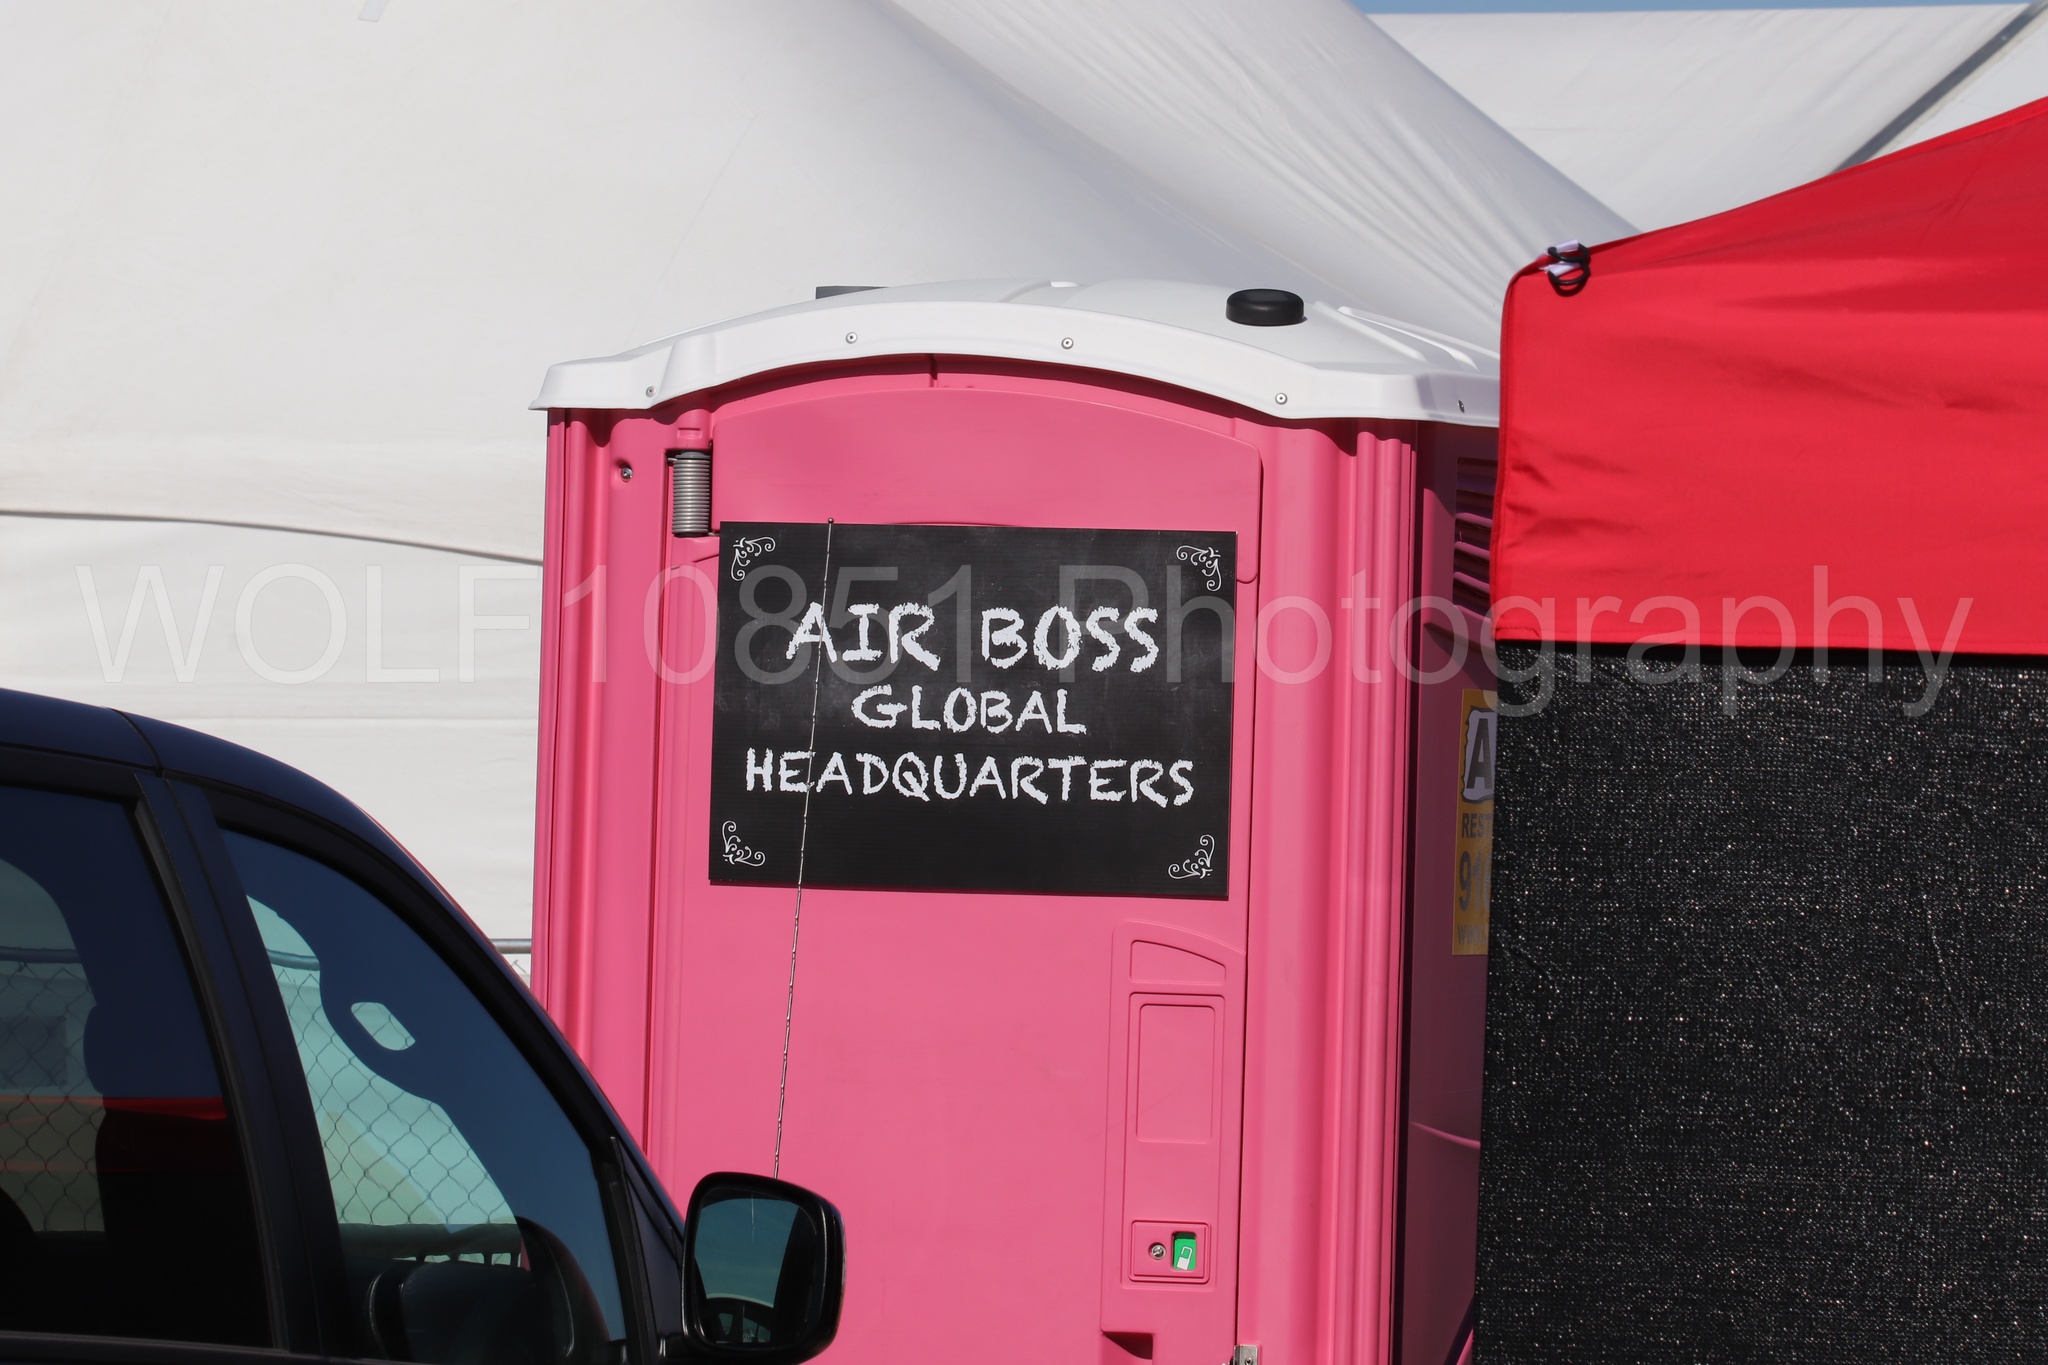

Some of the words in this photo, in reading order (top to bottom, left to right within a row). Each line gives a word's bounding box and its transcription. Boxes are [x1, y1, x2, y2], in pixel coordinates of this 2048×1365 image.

[786, 602, 940, 671] AIR
[981, 605, 1159, 673] BOSS
[851, 684, 1087, 735] GLOBAL
[745, 748, 1195, 808] HEADQUARTERS
